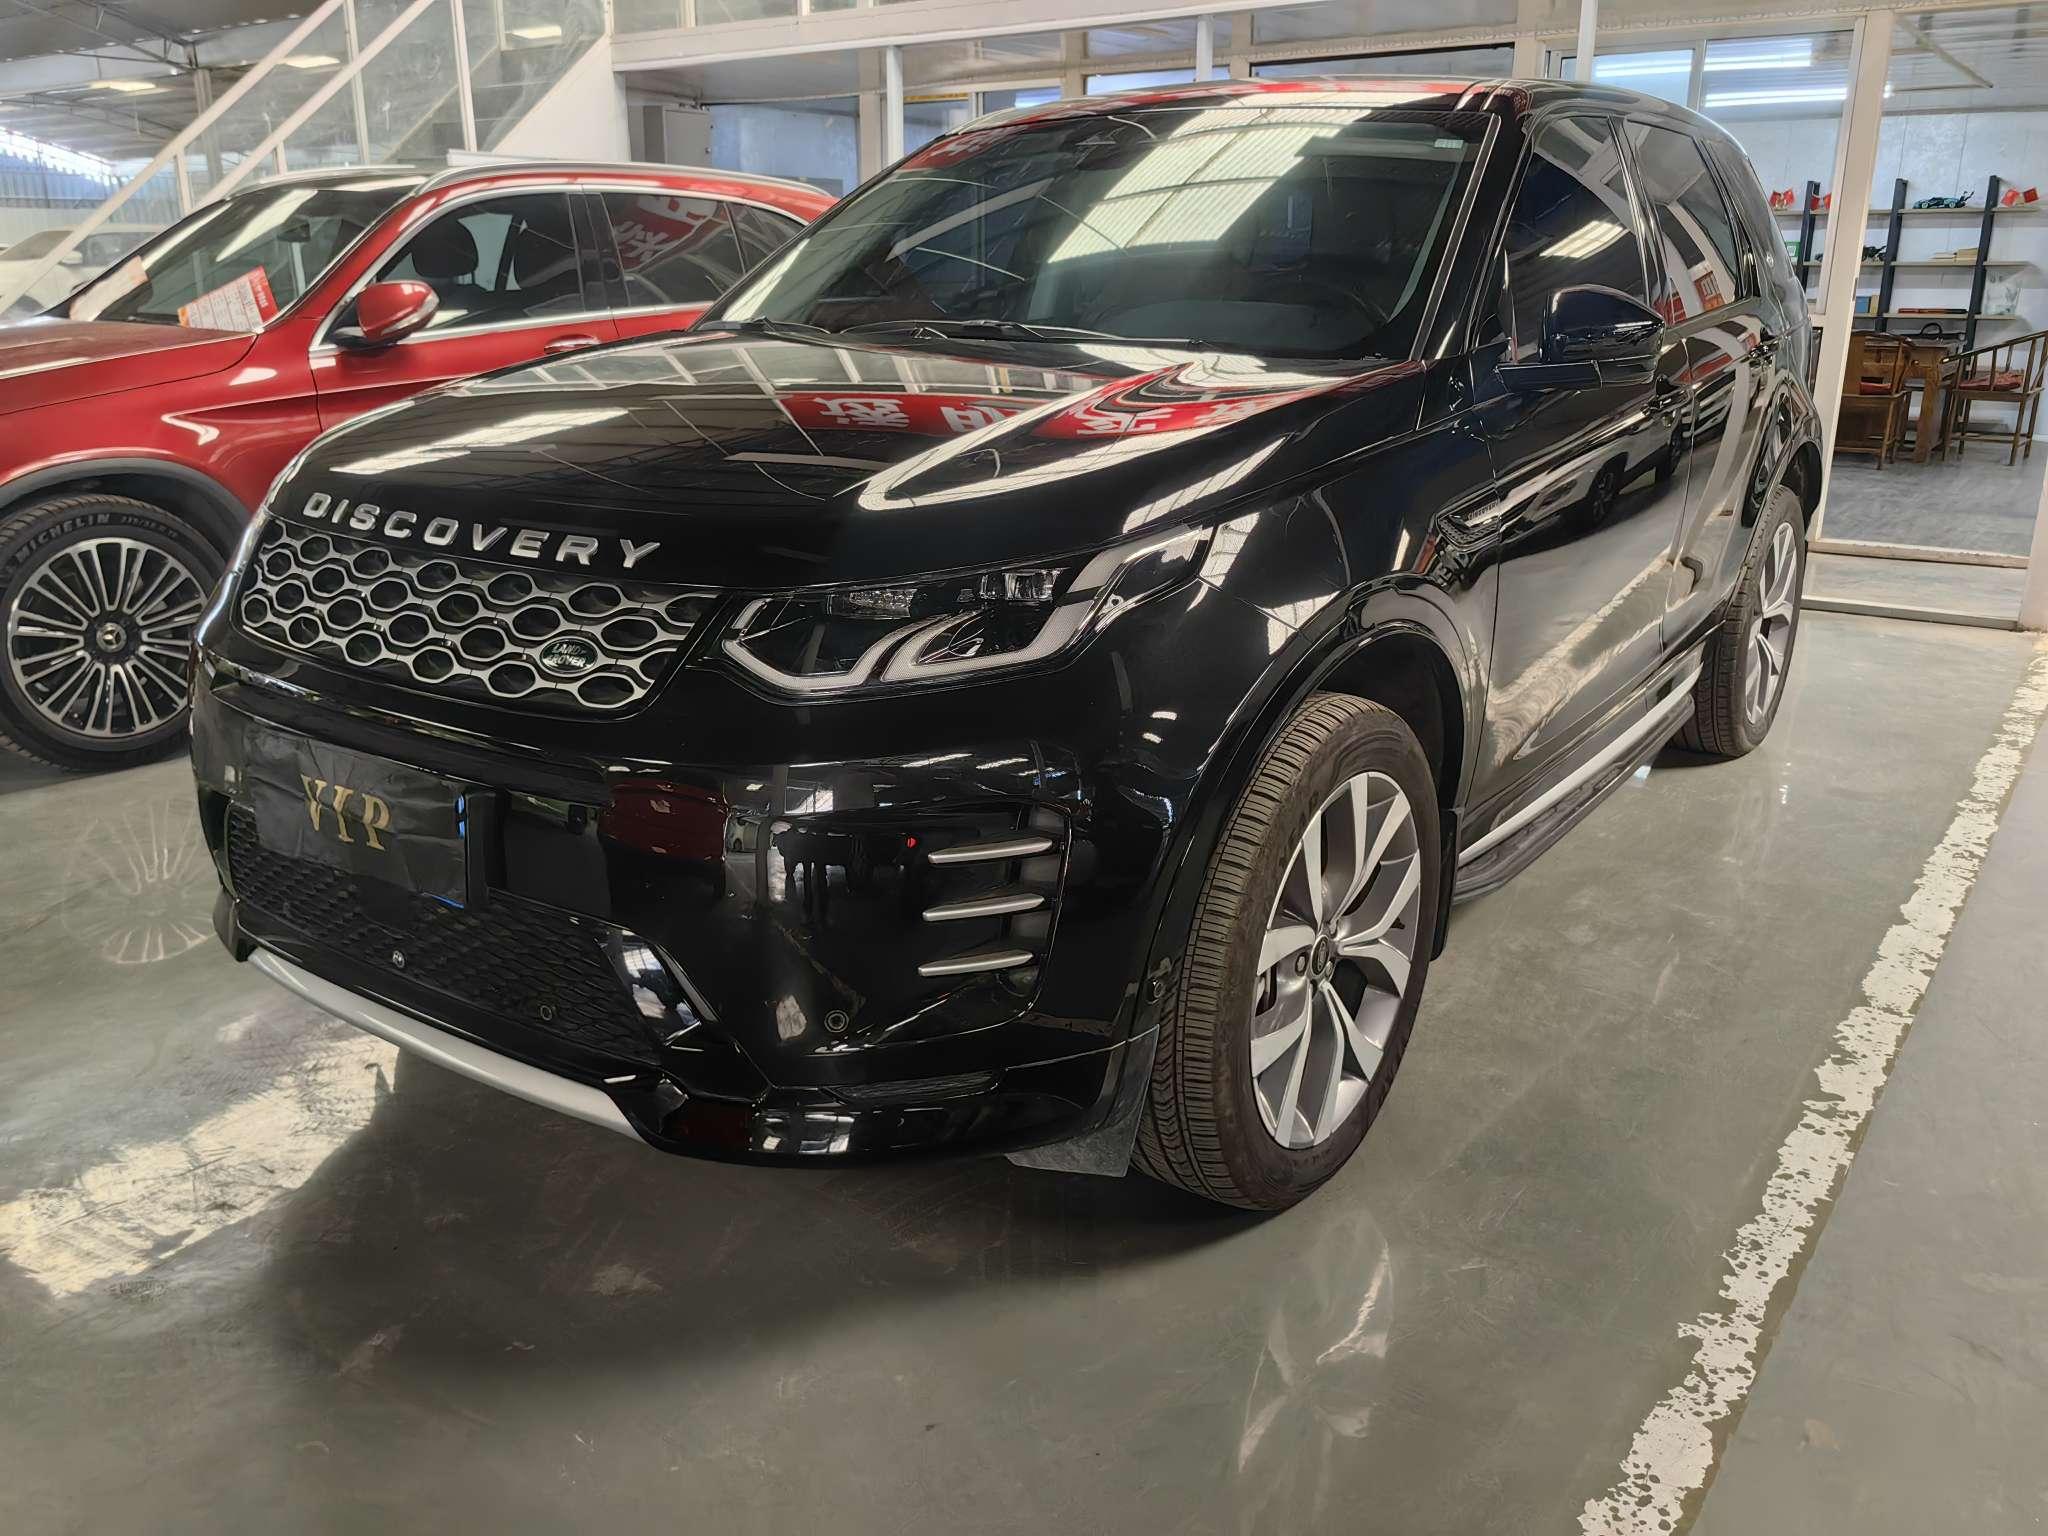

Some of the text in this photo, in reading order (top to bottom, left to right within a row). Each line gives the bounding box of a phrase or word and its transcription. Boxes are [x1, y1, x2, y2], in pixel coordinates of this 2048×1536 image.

[15, 513, 111, 563] MICHELIN
[303, 492, 660, 568] DISCOVERY
[301, 774, 393, 851] VIP
